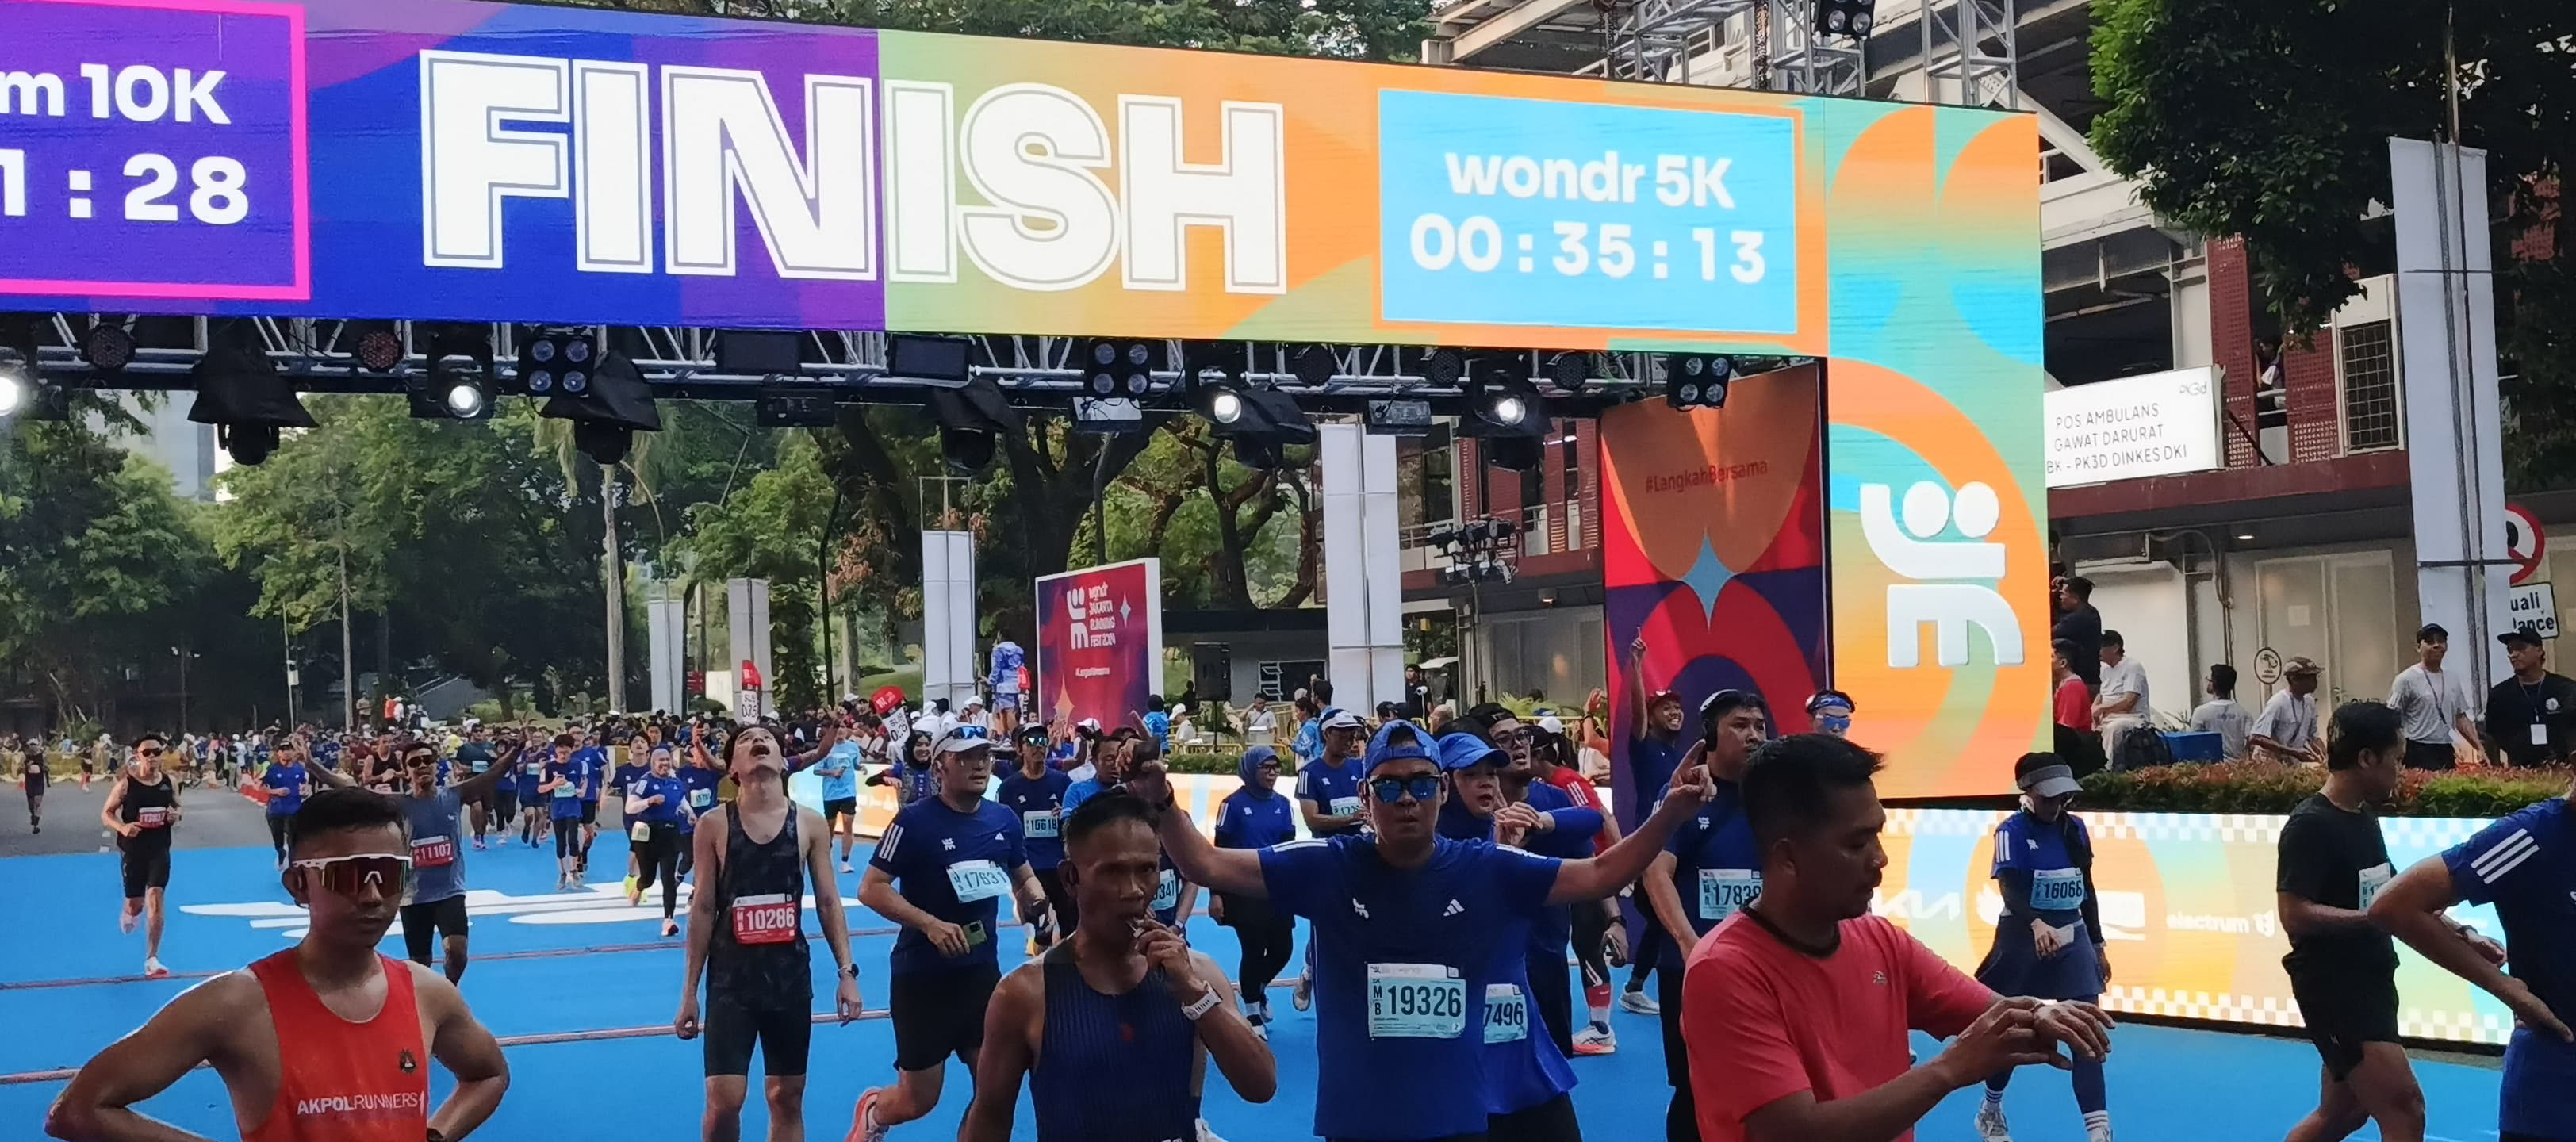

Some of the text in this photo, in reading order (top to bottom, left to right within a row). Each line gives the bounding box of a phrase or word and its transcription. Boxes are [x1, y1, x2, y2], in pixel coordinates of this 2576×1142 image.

[81, 63, 231, 125] 10K
[420, 49, 1286, 294] FINISH
[1444, 150, 1735, 209] wondr 5K
[2055, 402, 2160, 430] POS AMBULANS
[2054, 424, 2164, 452] GAWAT DARURAT
[2075, 454, 2108, 470] PK3D
[2112, 446, 2160, 466] DINKES
[2164, 443, 2187, 459] DKI
[1646, 460, 1768, 493] #LangkahBersama
[420, 843, 451, 860] 11107
[964, 871, 1007, 889] 17631
[2044, 879, 2083, 899] 16066
[746, 907, 795, 931] 10286
[2166, 910, 2250, 933] electrum
[1387, 985, 1462, 1017] 19326
[297, 1093, 418, 1115] AKPOLRUNNERS
